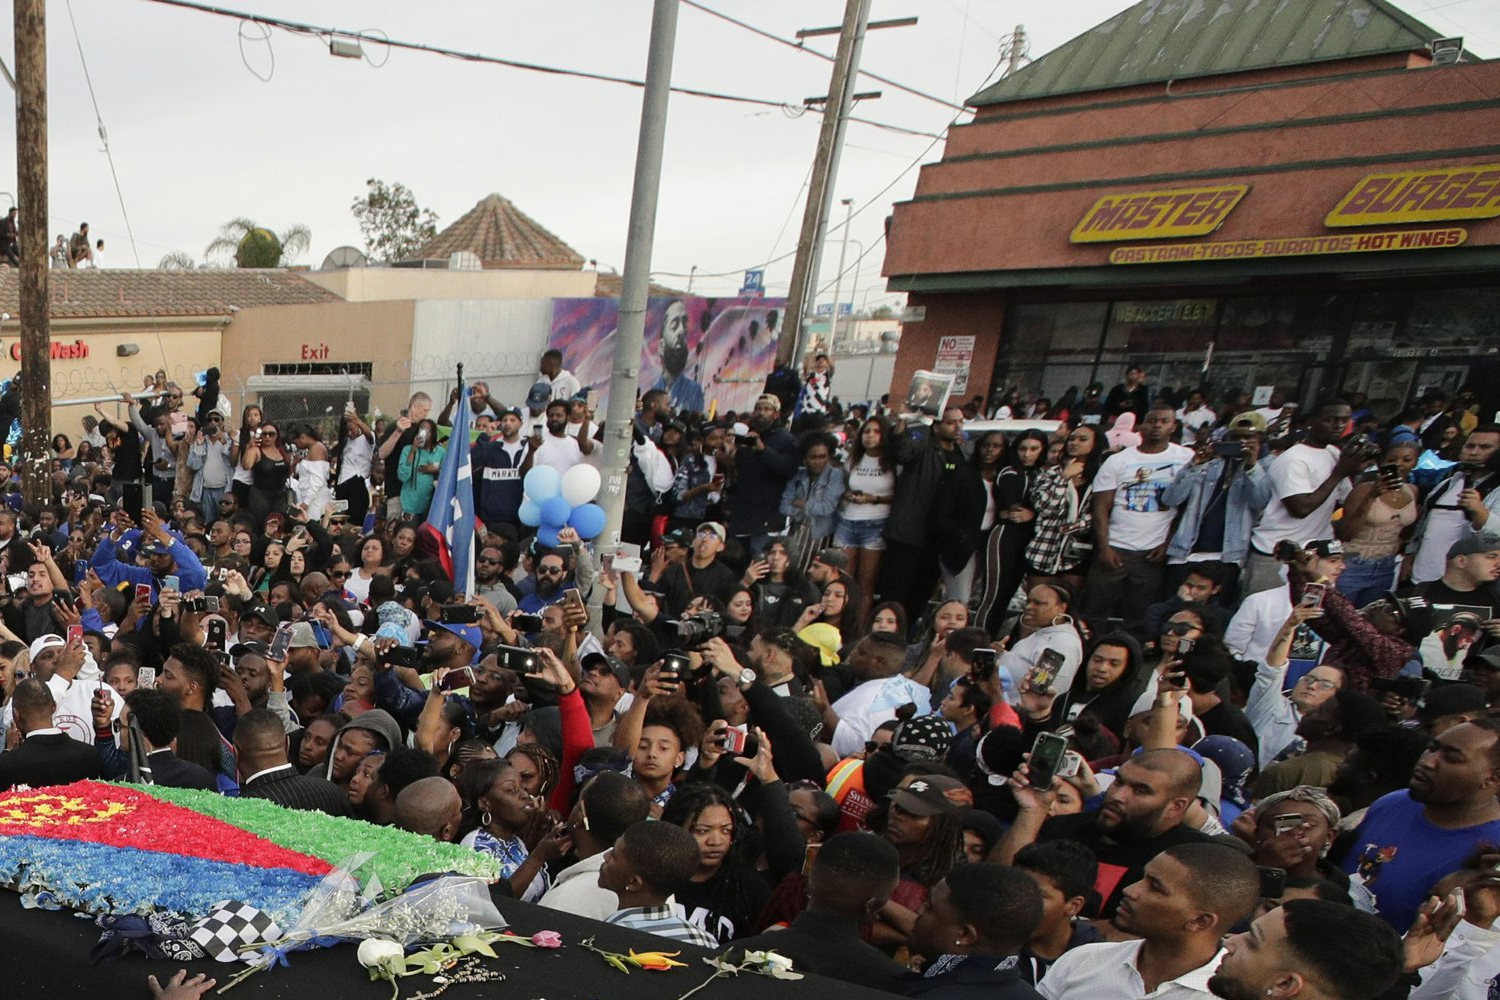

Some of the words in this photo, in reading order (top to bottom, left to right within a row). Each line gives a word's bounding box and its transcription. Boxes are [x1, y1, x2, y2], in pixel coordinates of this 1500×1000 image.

[1082, 189, 1240, 232] MASTER
[1401, 230, 1461, 247] WINGS
[302, 343, 330, 360] Exit
[942, 338, 957, 349] NO
